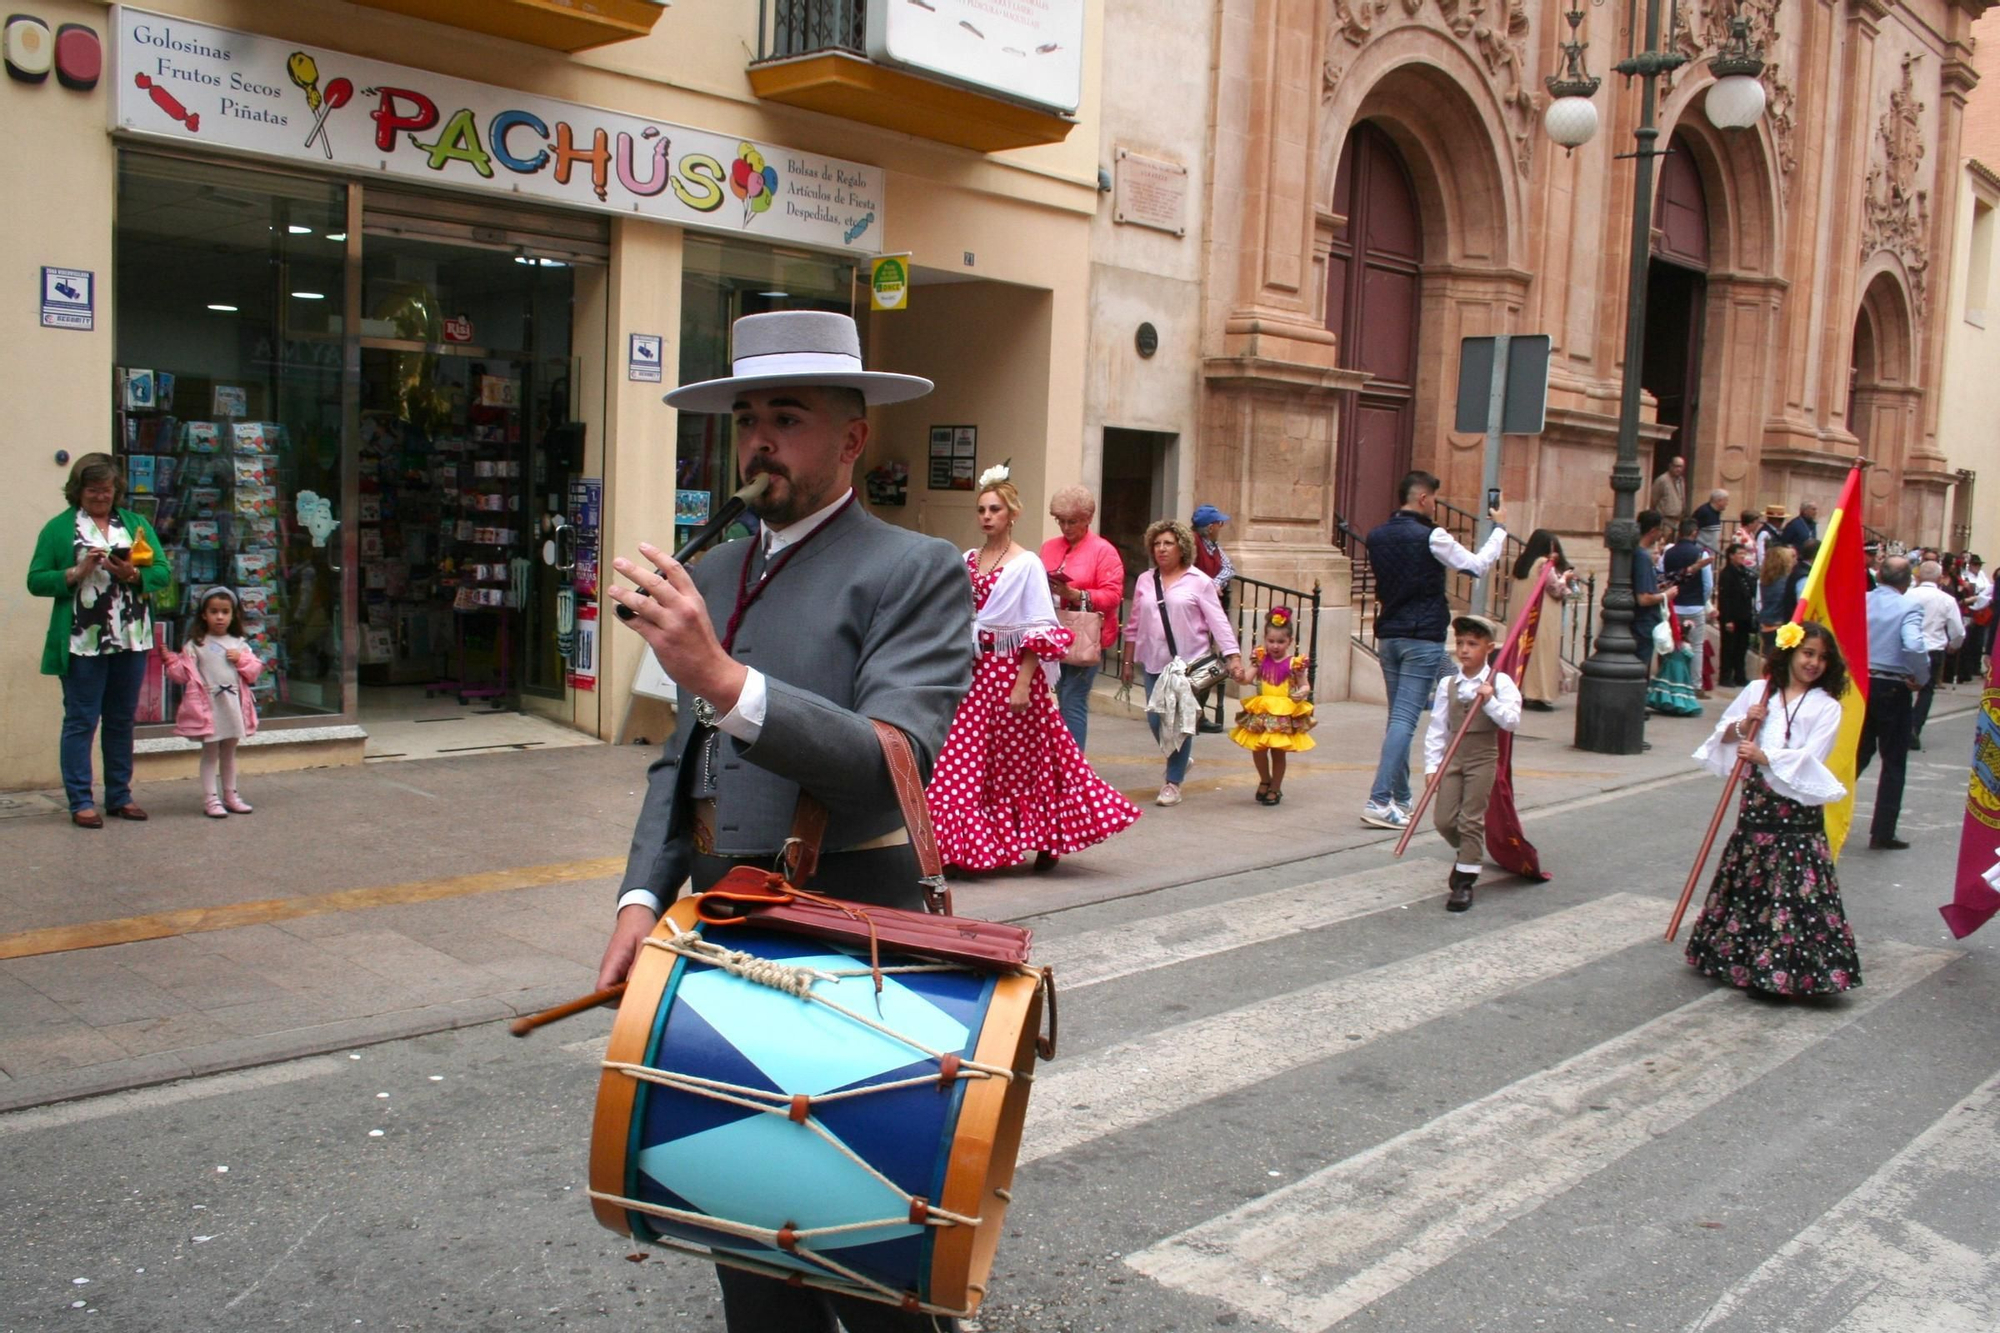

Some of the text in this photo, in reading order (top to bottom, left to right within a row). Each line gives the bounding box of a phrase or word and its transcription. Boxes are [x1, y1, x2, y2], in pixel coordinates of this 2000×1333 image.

[133, 25, 232, 61] Golosinas
[156, 57, 282, 98] Frutos Secos
[220, 97, 288, 126] Piñatas
[370, 86, 726, 212] PACHÚS
[787, 159, 867, 188] Bolsas de Regalo
[787, 180, 875, 210] Artículos de Fiesta
[786, 201, 841, 226] Despedidas,
[965, 253, 974, 266] 21
[883, 283, 901, 292] ONCE
